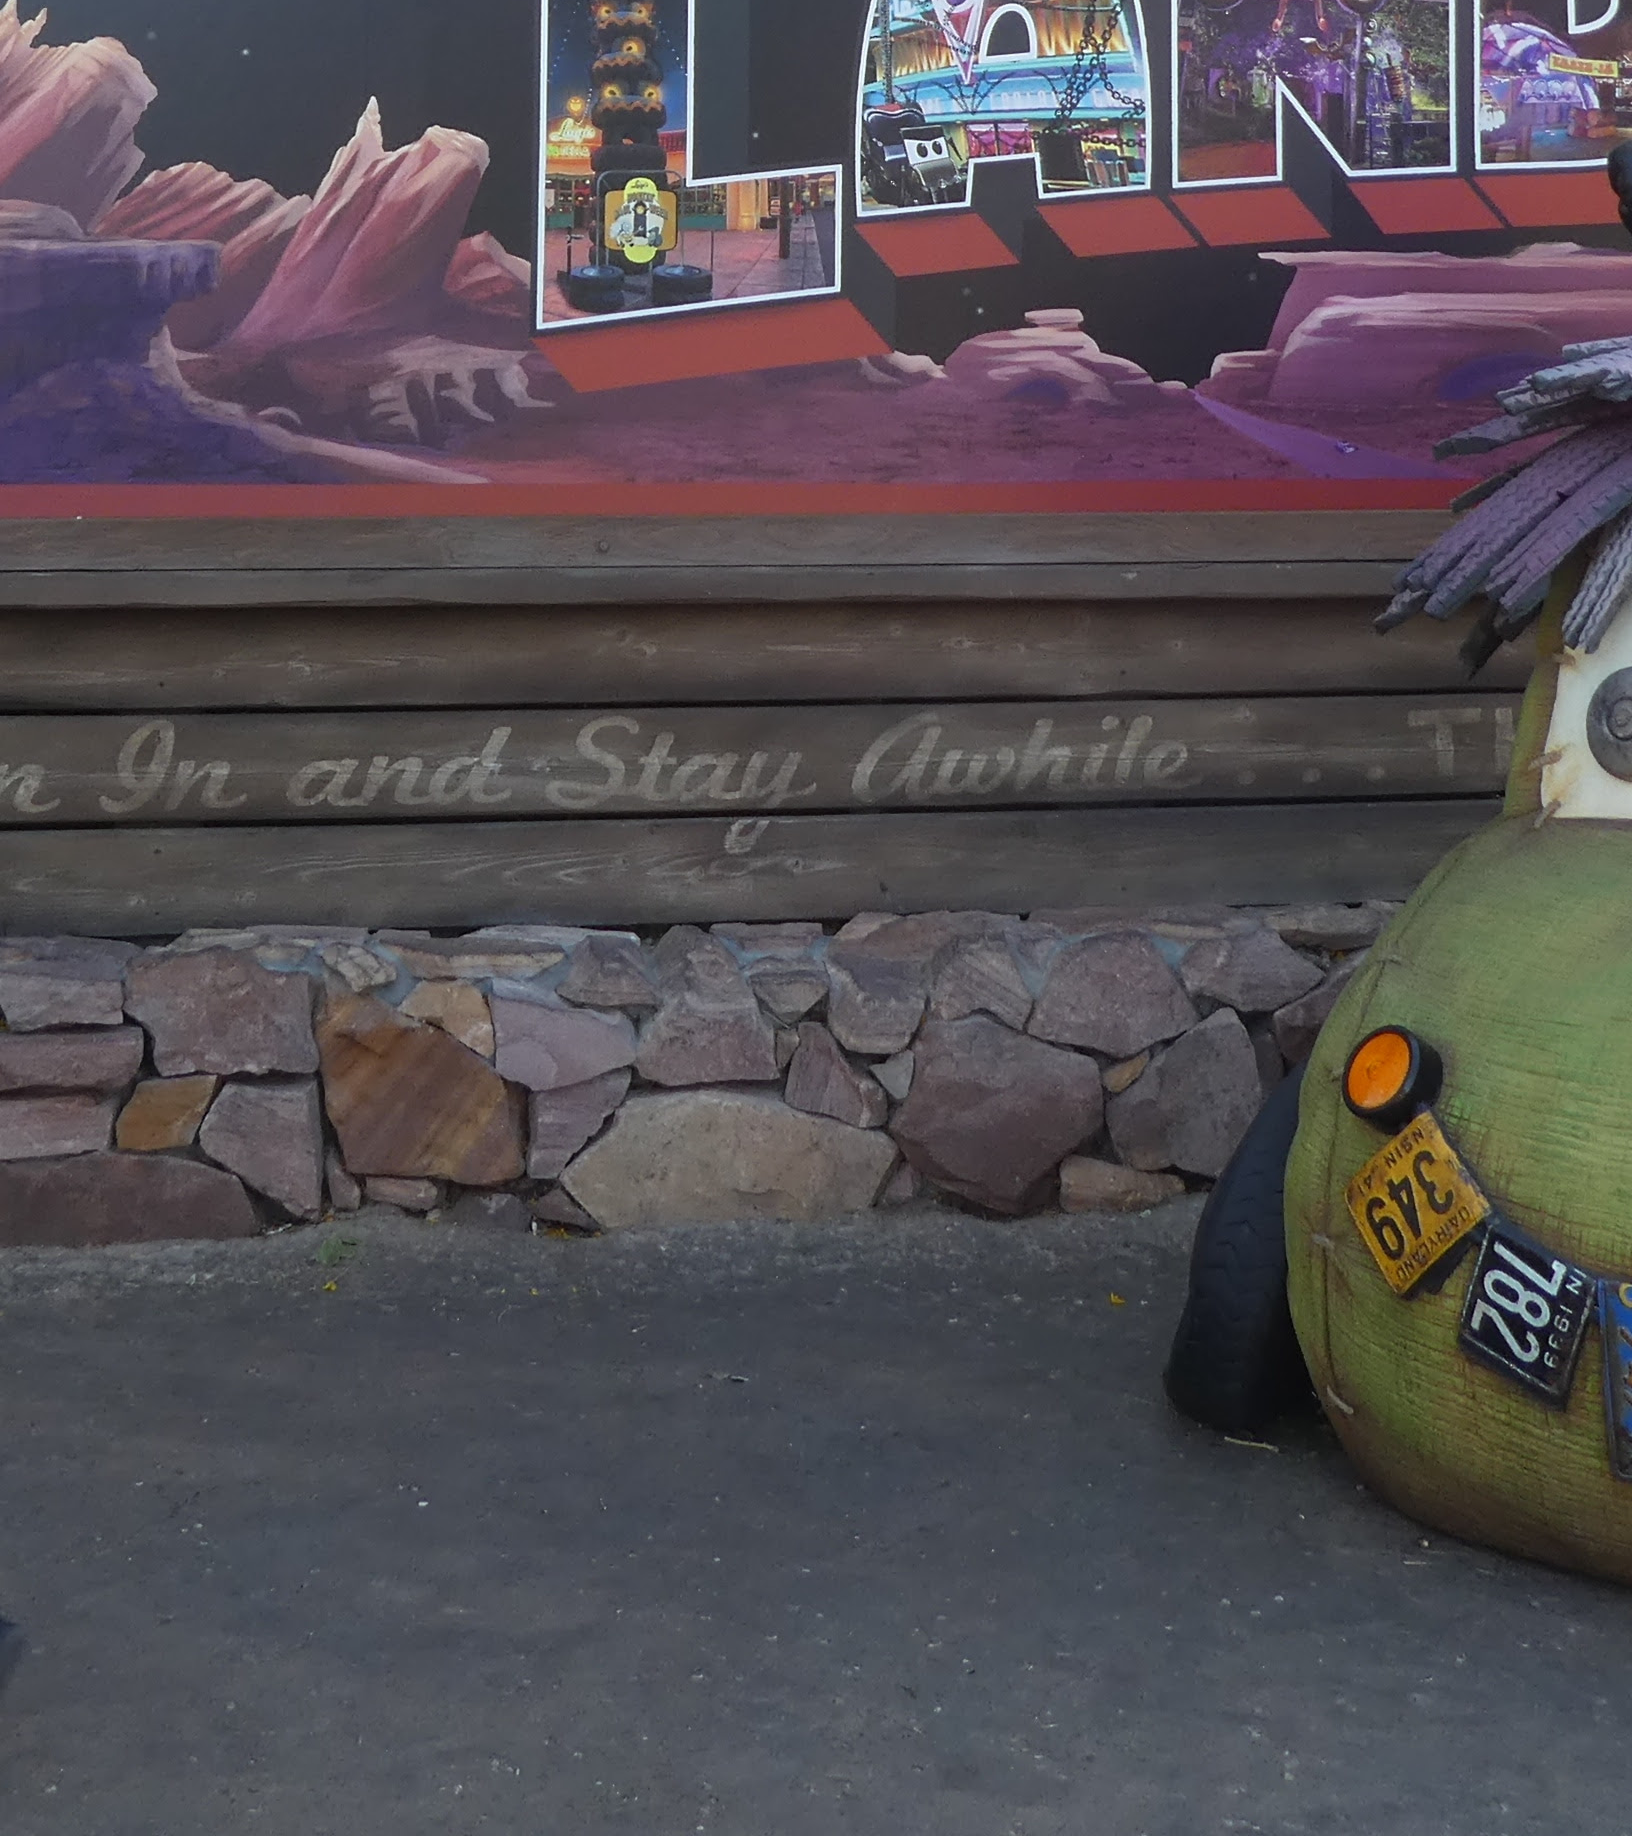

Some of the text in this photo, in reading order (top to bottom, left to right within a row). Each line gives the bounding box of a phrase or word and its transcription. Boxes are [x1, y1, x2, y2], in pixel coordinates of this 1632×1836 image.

[98, 719, 248, 814] In
[285, 726, 514, 807] and
[544, 714, 818, 855] Stay
[1365, 1149, 1456, 1262] 349
[1470, 1240, 1567, 1363] 782
